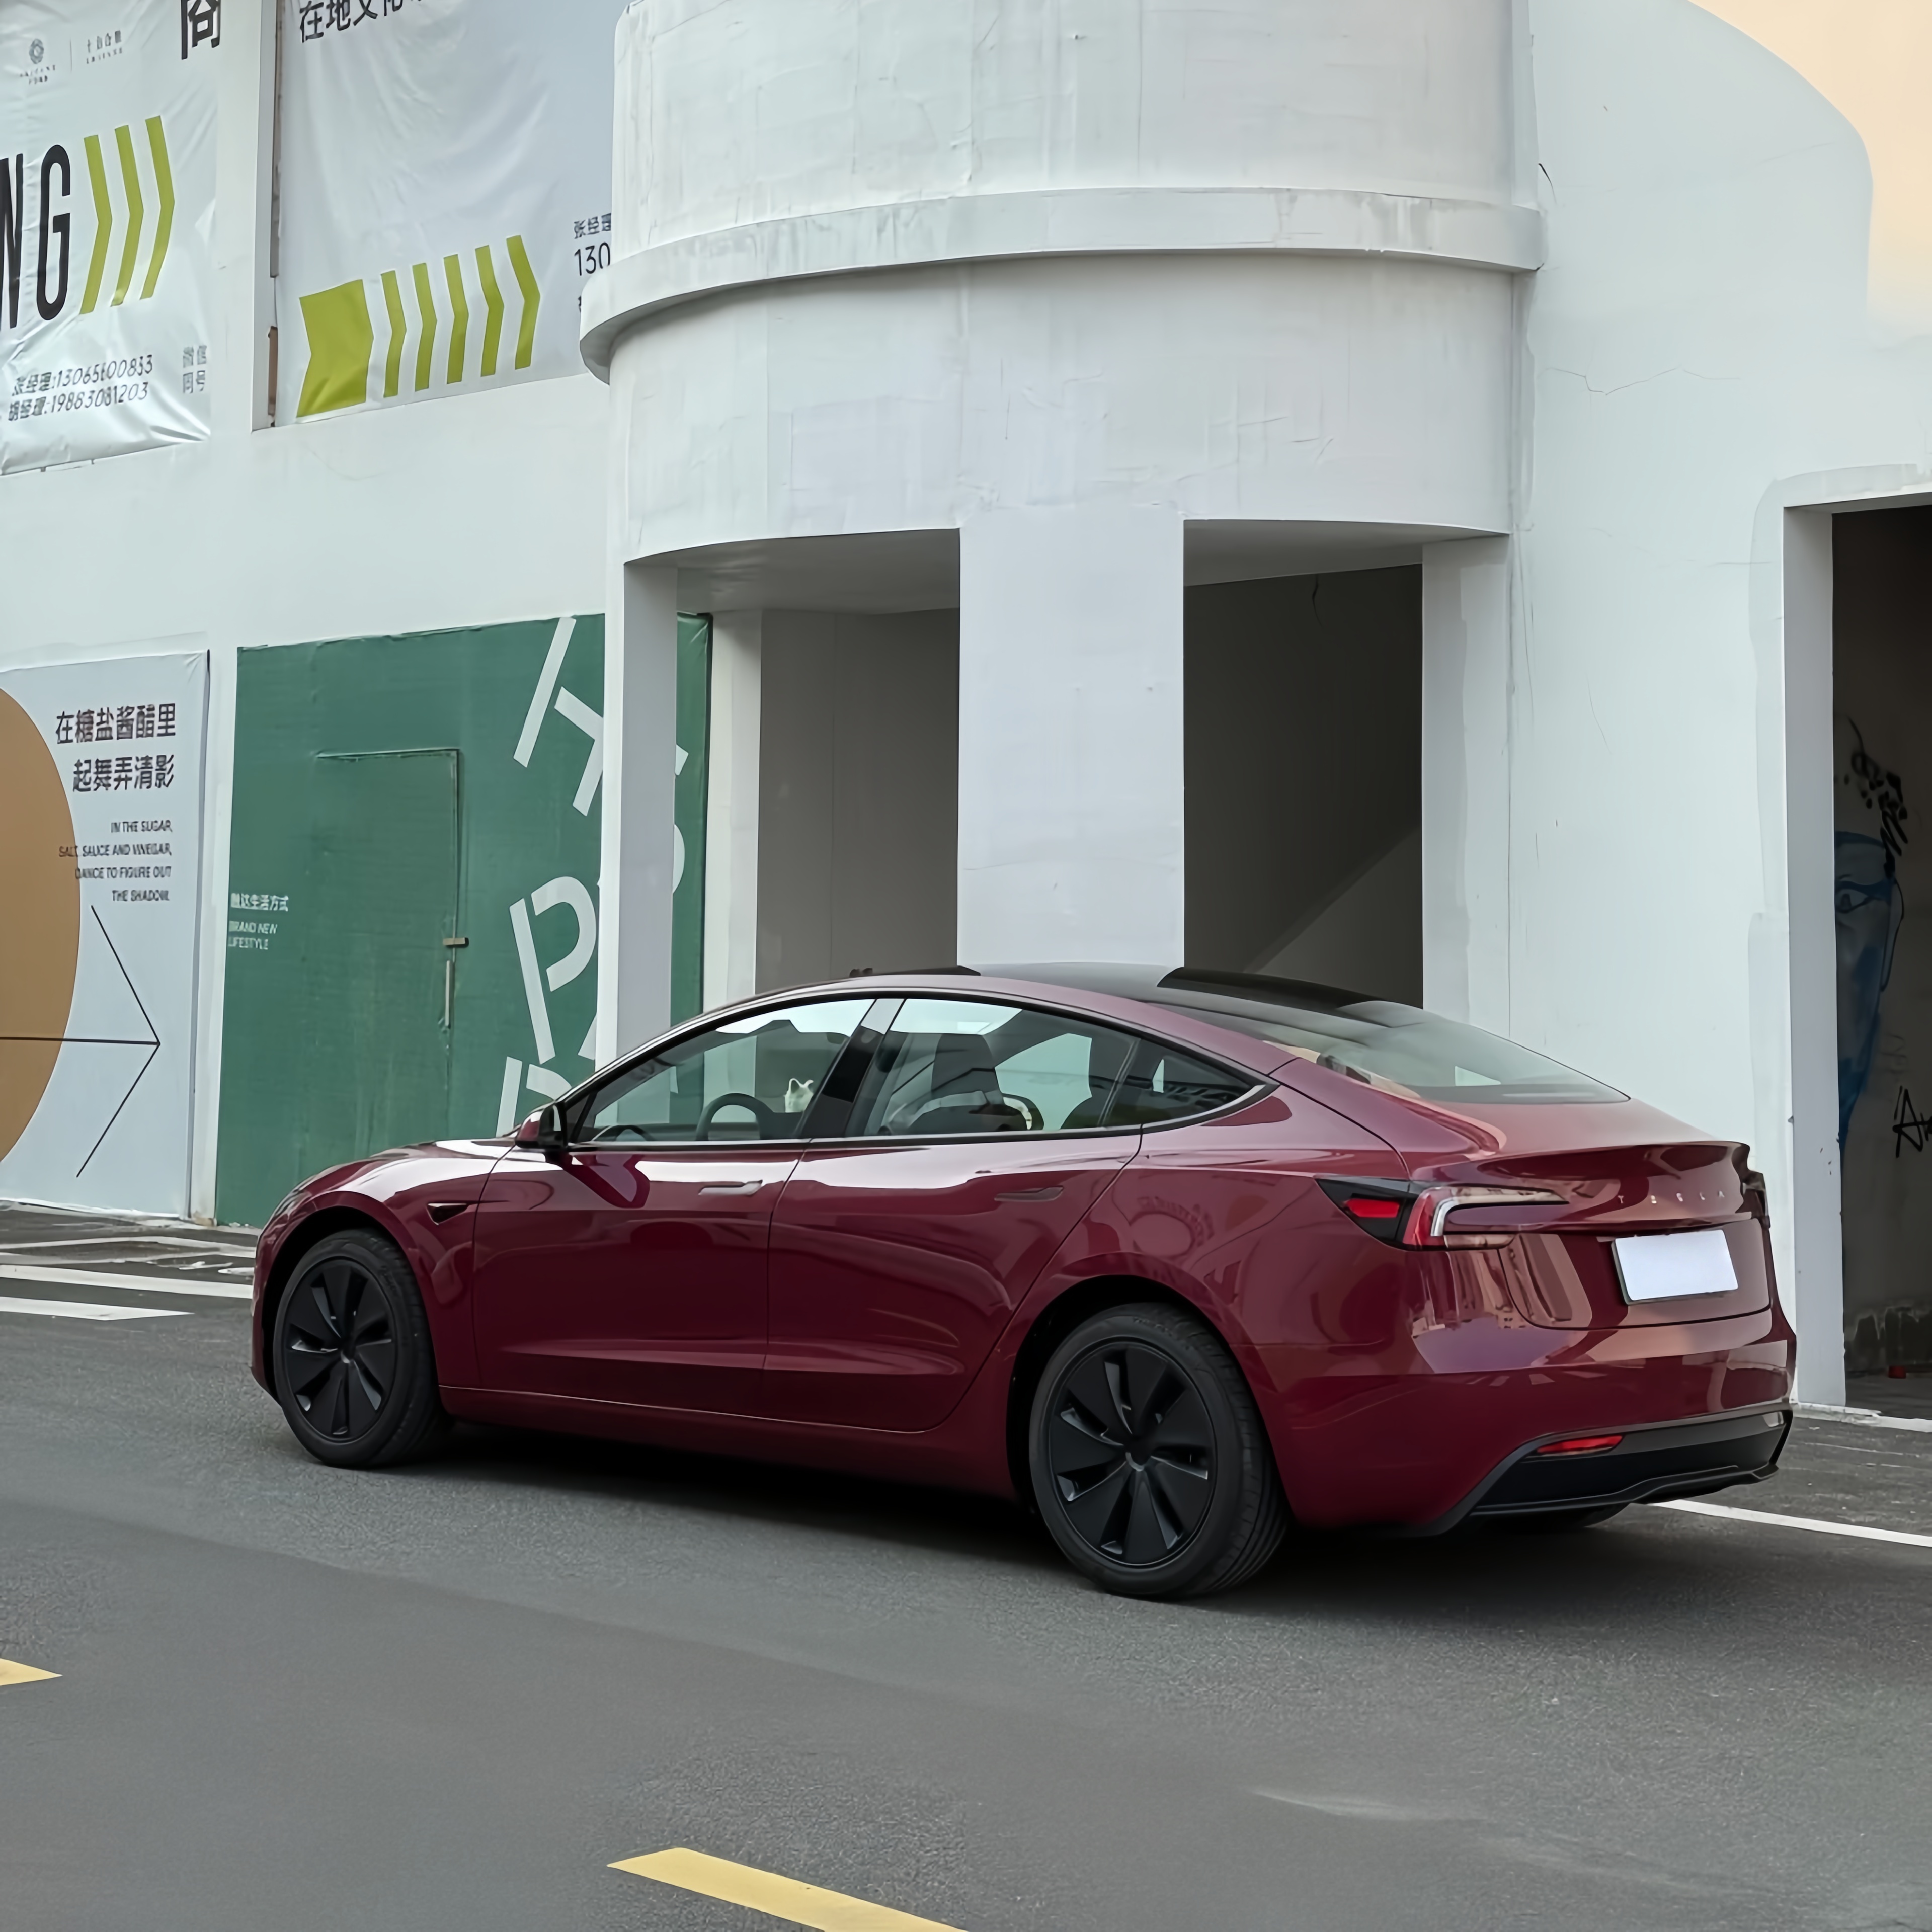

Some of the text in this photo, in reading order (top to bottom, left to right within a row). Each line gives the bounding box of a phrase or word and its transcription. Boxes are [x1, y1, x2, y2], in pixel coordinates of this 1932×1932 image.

[55, 703, 176, 744] 在糖盐酱醋里
[72, 754, 174, 792] 起舞弄清影
[123, 821, 138, 832] THE
[112, 844, 130, 855] AND
[106, 867, 118, 878] TO
[119, 866, 151, 878] FIGURE
[153, 866, 172, 878] OUT
[112, 890, 128, 901] THE
